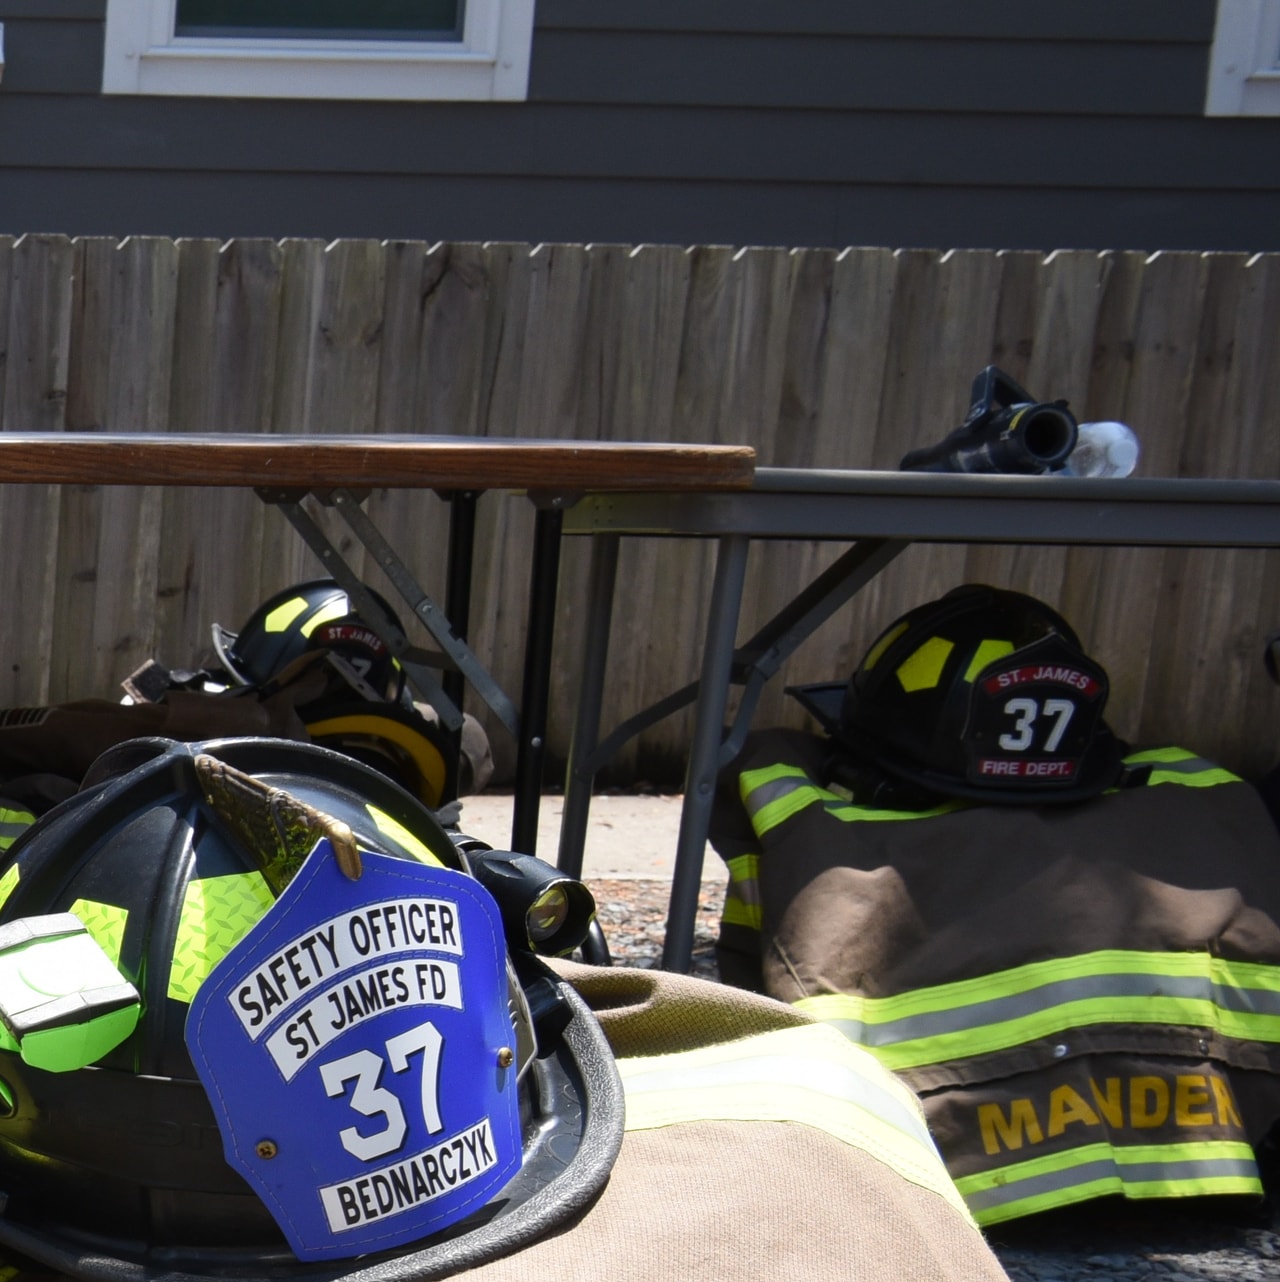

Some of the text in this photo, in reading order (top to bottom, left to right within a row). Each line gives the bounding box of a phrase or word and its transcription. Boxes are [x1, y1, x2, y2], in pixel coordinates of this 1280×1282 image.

[349, 630, 382, 650] JAMES
[998, 667, 1089, 689] ST. JAMES
[999, 698, 1075, 752] 37
[982, 761, 1070, 776] FIRE DEPT.
[239, 904, 456, 1027] SAFETY OFFICER
[285, 964, 447, 1060] ST JAMES FD
[319, 1021, 444, 1162] 37
[336, 1131, 494, 1227] BEDNARCZYK
